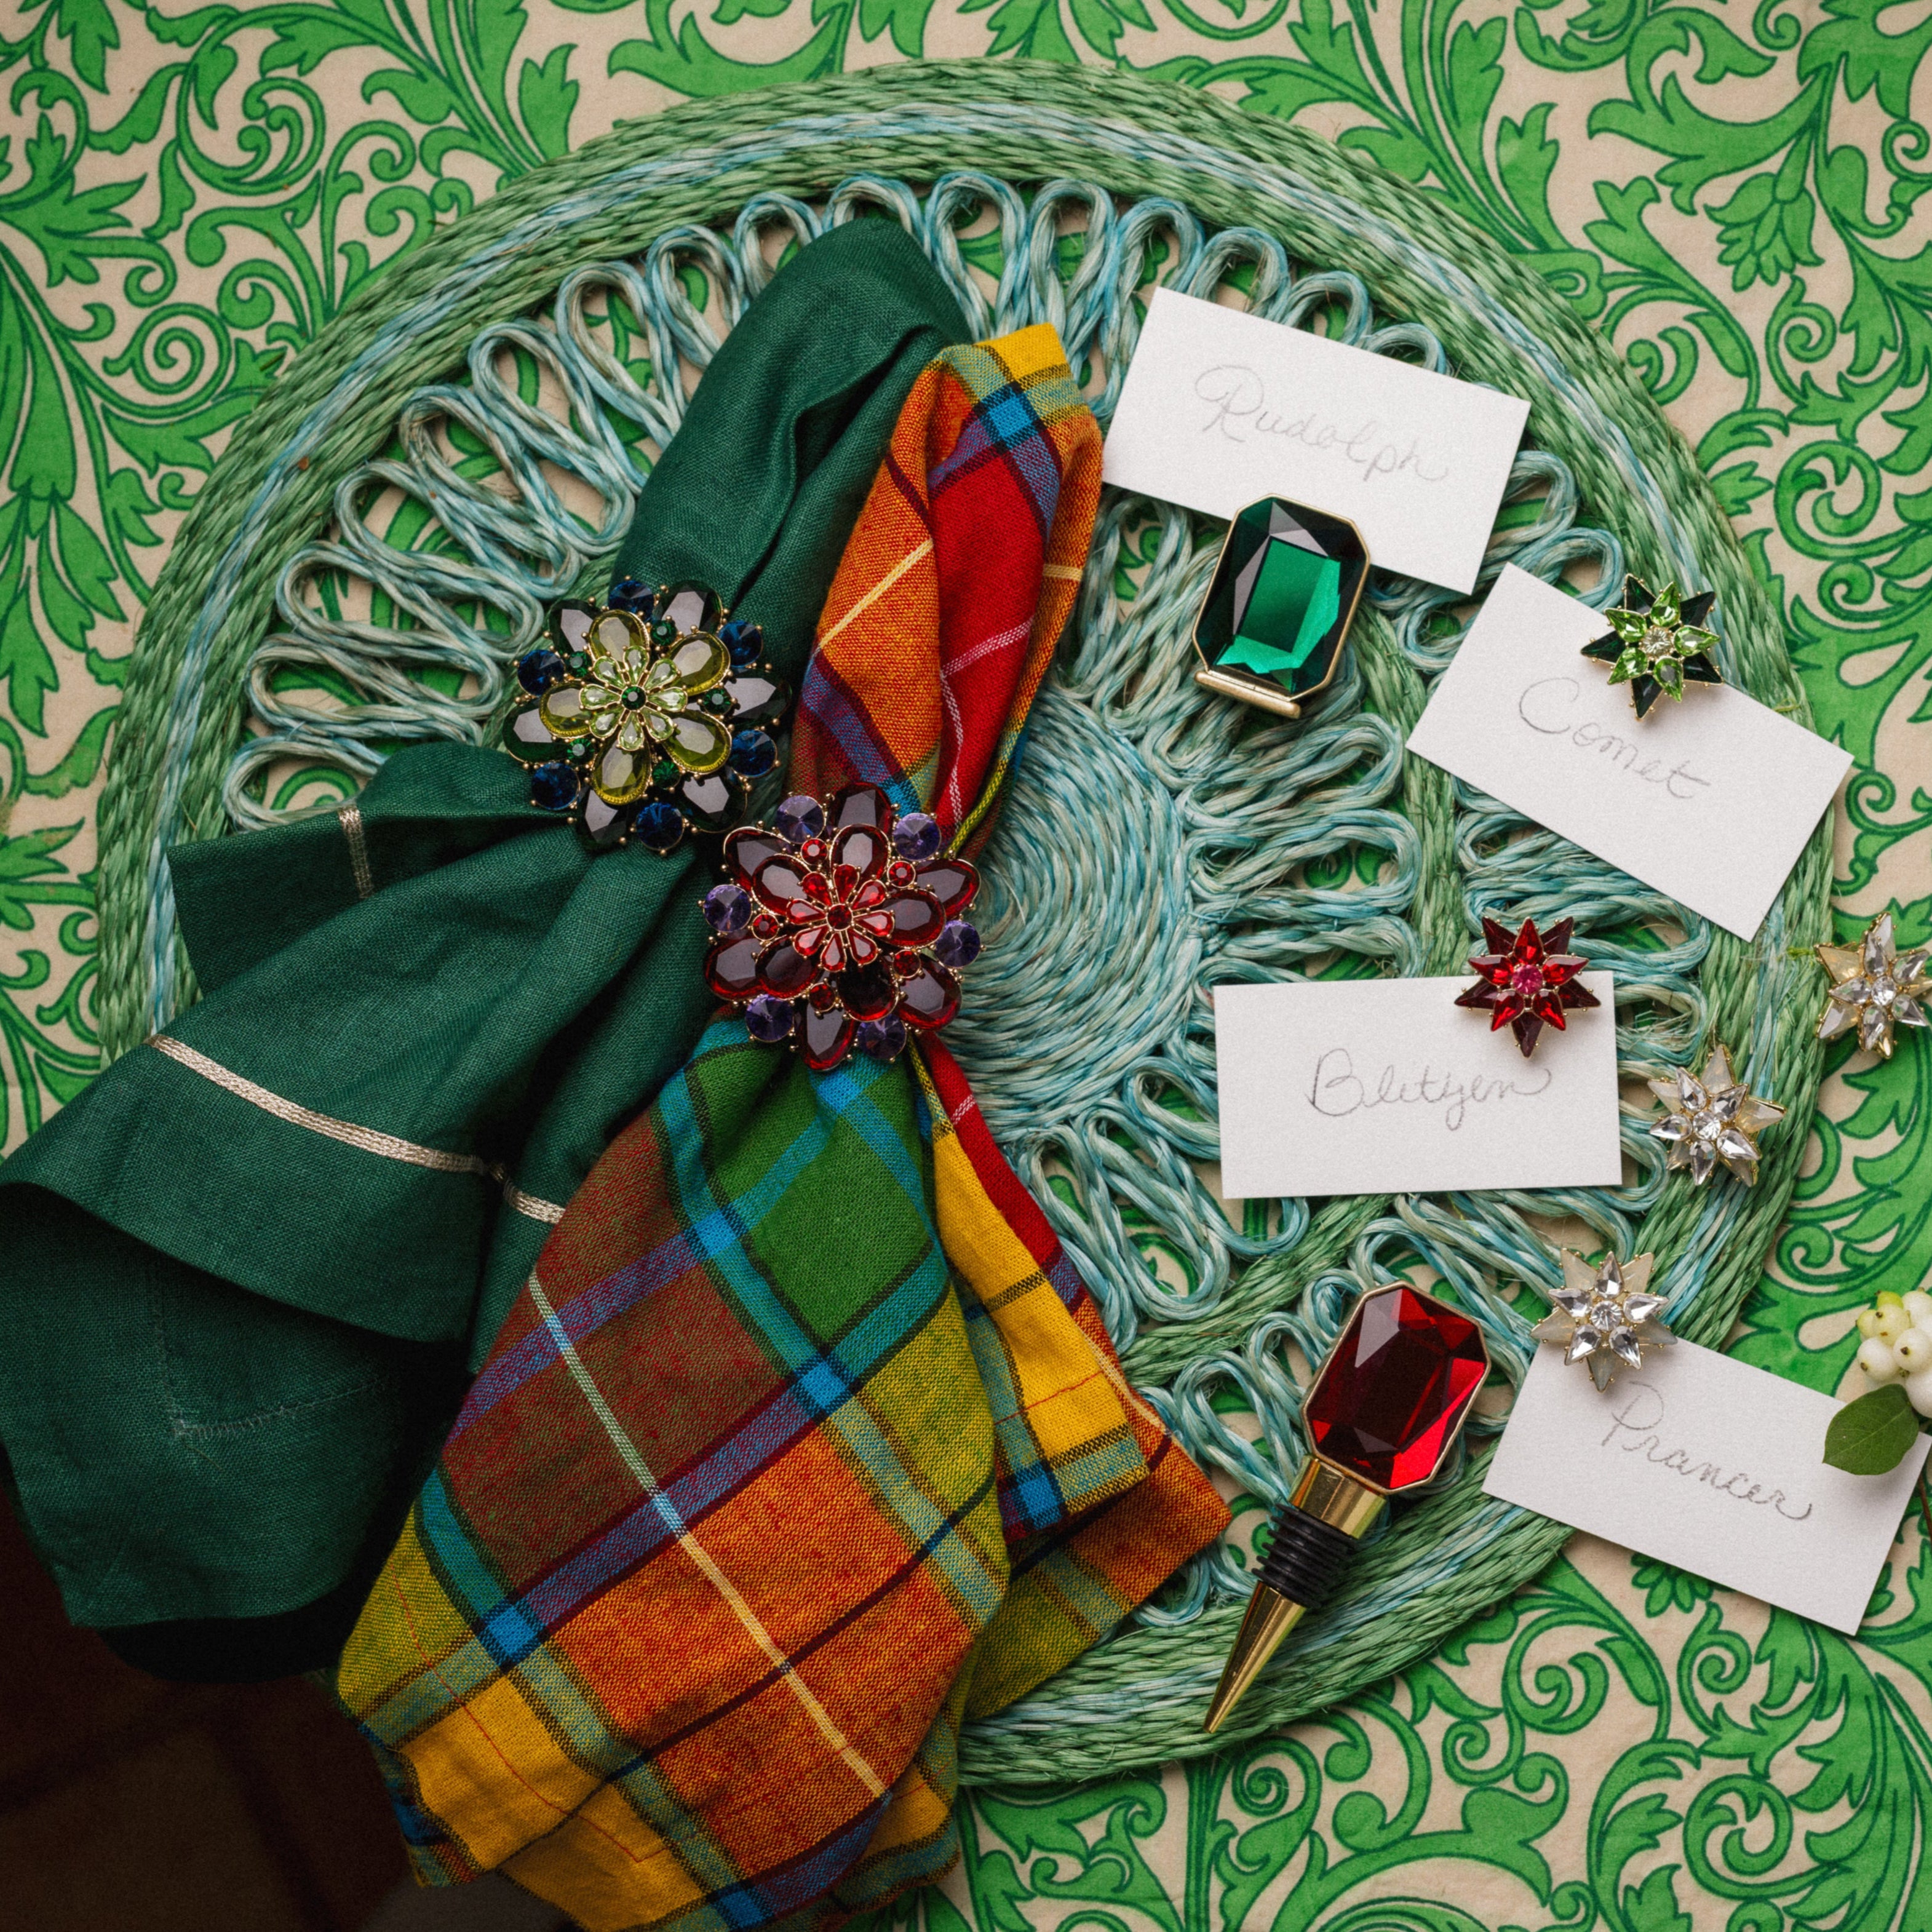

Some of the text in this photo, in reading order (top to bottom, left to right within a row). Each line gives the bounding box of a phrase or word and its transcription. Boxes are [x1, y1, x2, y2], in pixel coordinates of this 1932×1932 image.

[1195, 365, 1449, 482] Rudolph
[1519, 677, 1711, 798] Comet
[1602, 1381, 1812, 1520] Prancer
